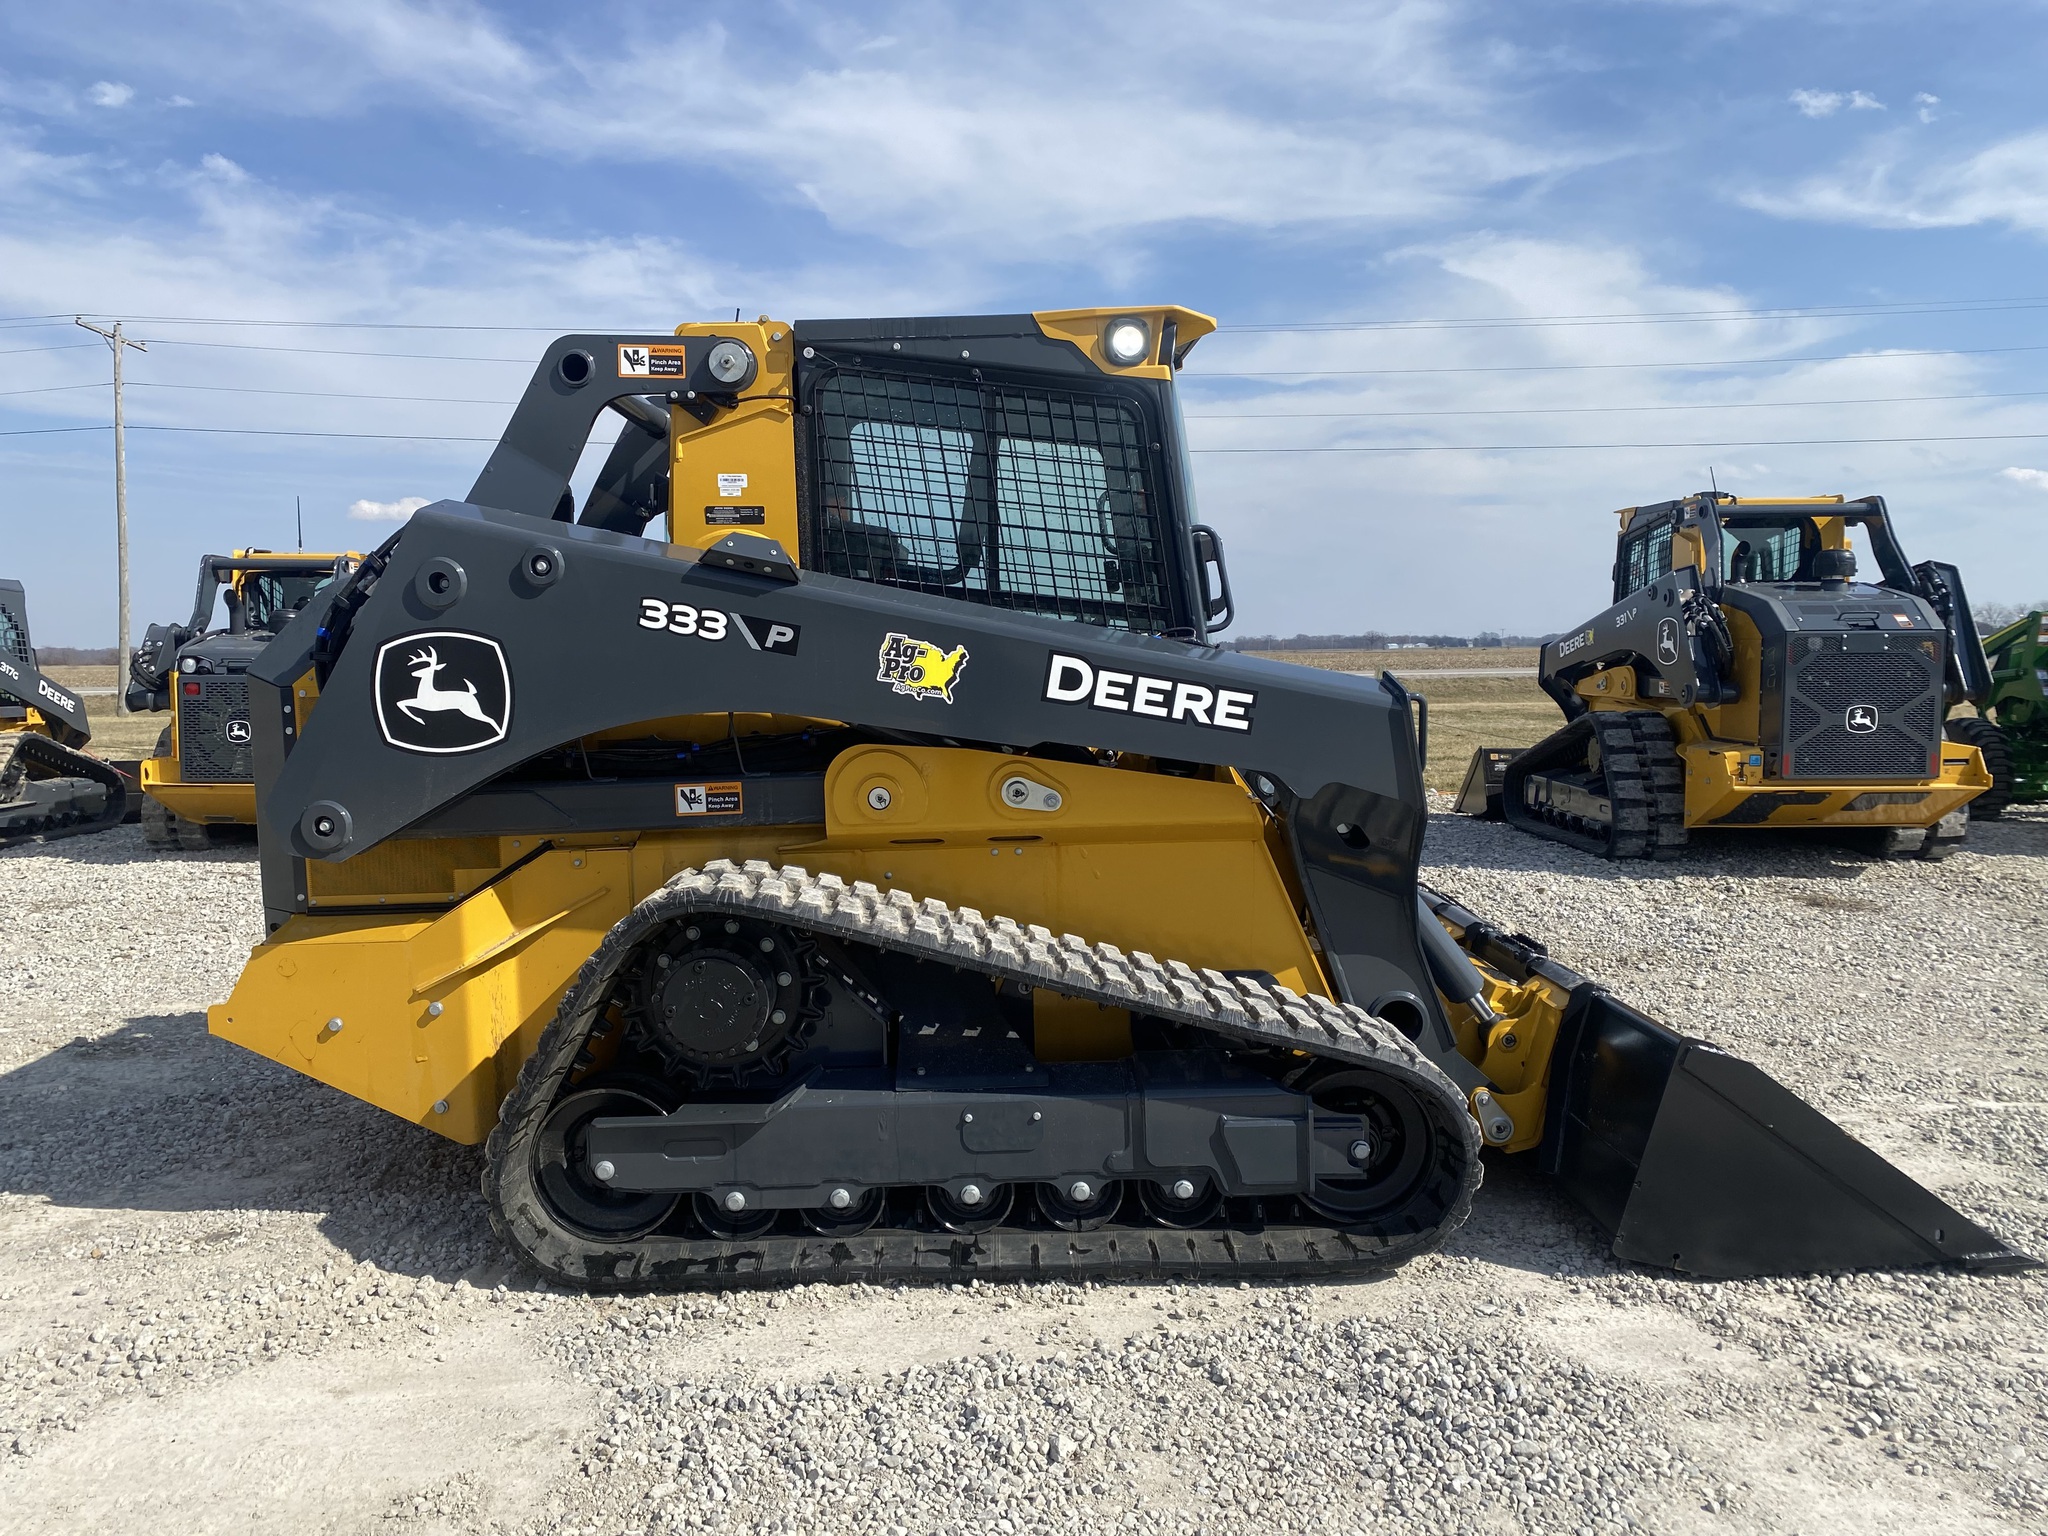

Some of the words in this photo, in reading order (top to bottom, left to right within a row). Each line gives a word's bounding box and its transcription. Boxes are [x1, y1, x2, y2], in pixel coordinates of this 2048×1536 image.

[639, 598, 728, 640] 333
[764, 624, 795, 649] P
[1615, 613, 1628, 628] 331
[883, 636, 928, 665] Ag-
[1559, 633, 1585, 658] DEERE
[0, 661, 19, 681] 317G
[881, 657, 925, 682] Pro
[38, 679, 76, 713] DEERE
[895, 683, 942, 695] AgProCo.com
[1046, 654, 1254, 731] DEERE
